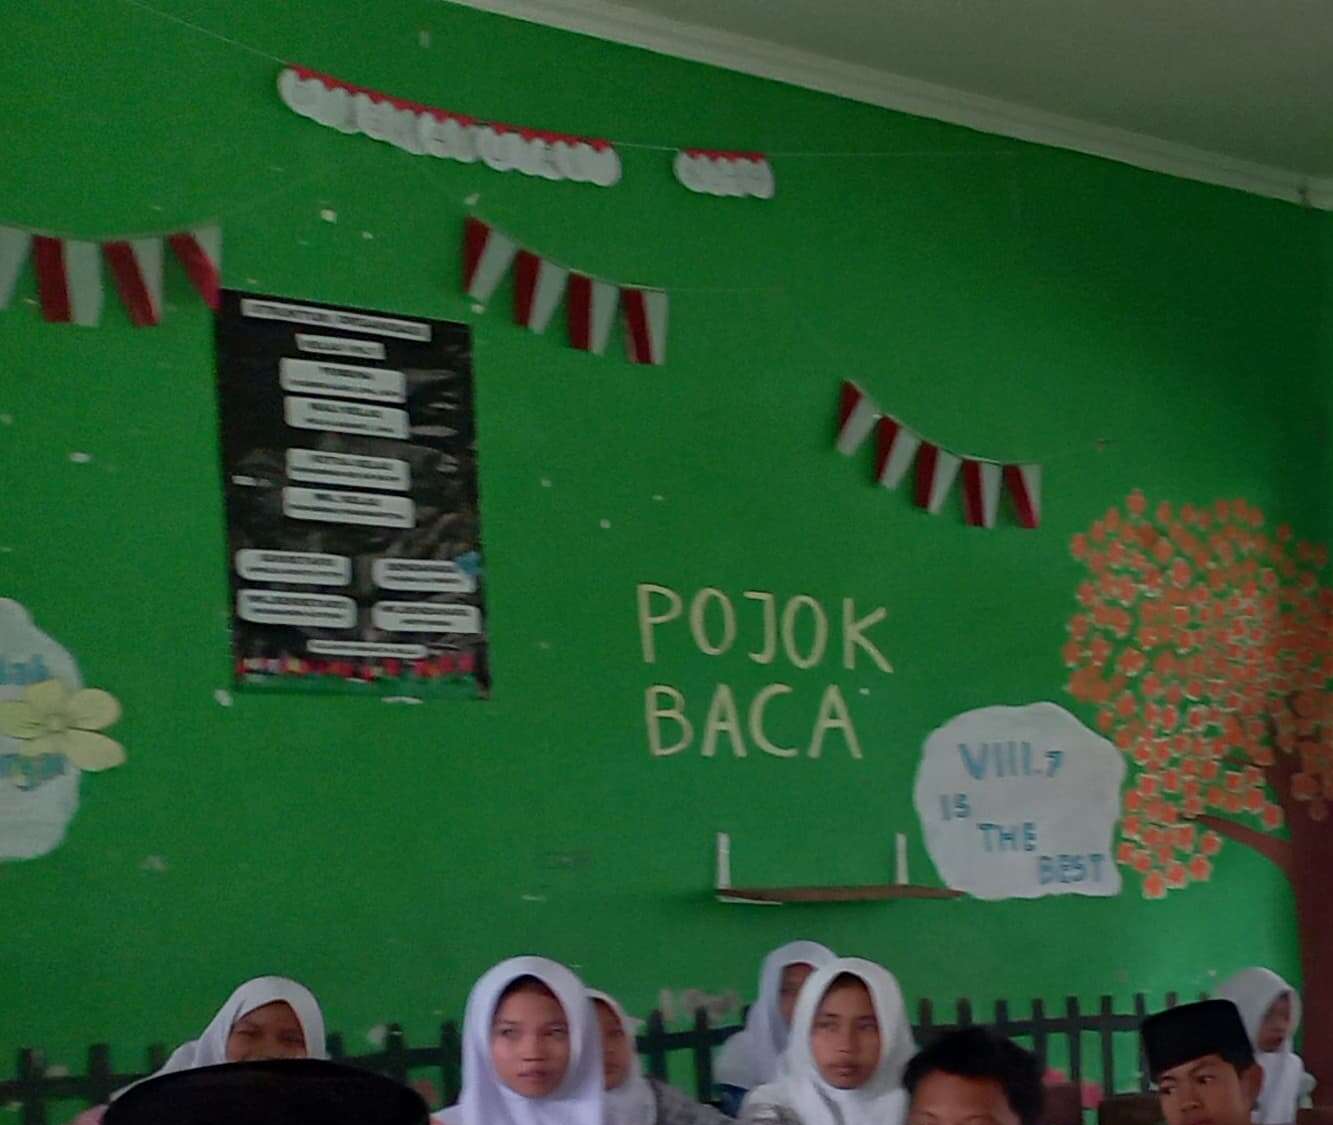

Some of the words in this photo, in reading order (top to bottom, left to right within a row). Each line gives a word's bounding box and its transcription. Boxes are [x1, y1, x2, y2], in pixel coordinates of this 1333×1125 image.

[637, 583, 894, 673] POJOK
[645, 683, 863, 759] BACA
[940, 793, 971, 821] IS
[977, 822, 1037, 852] THE
[1039, 854, 1104, 885] BEST
